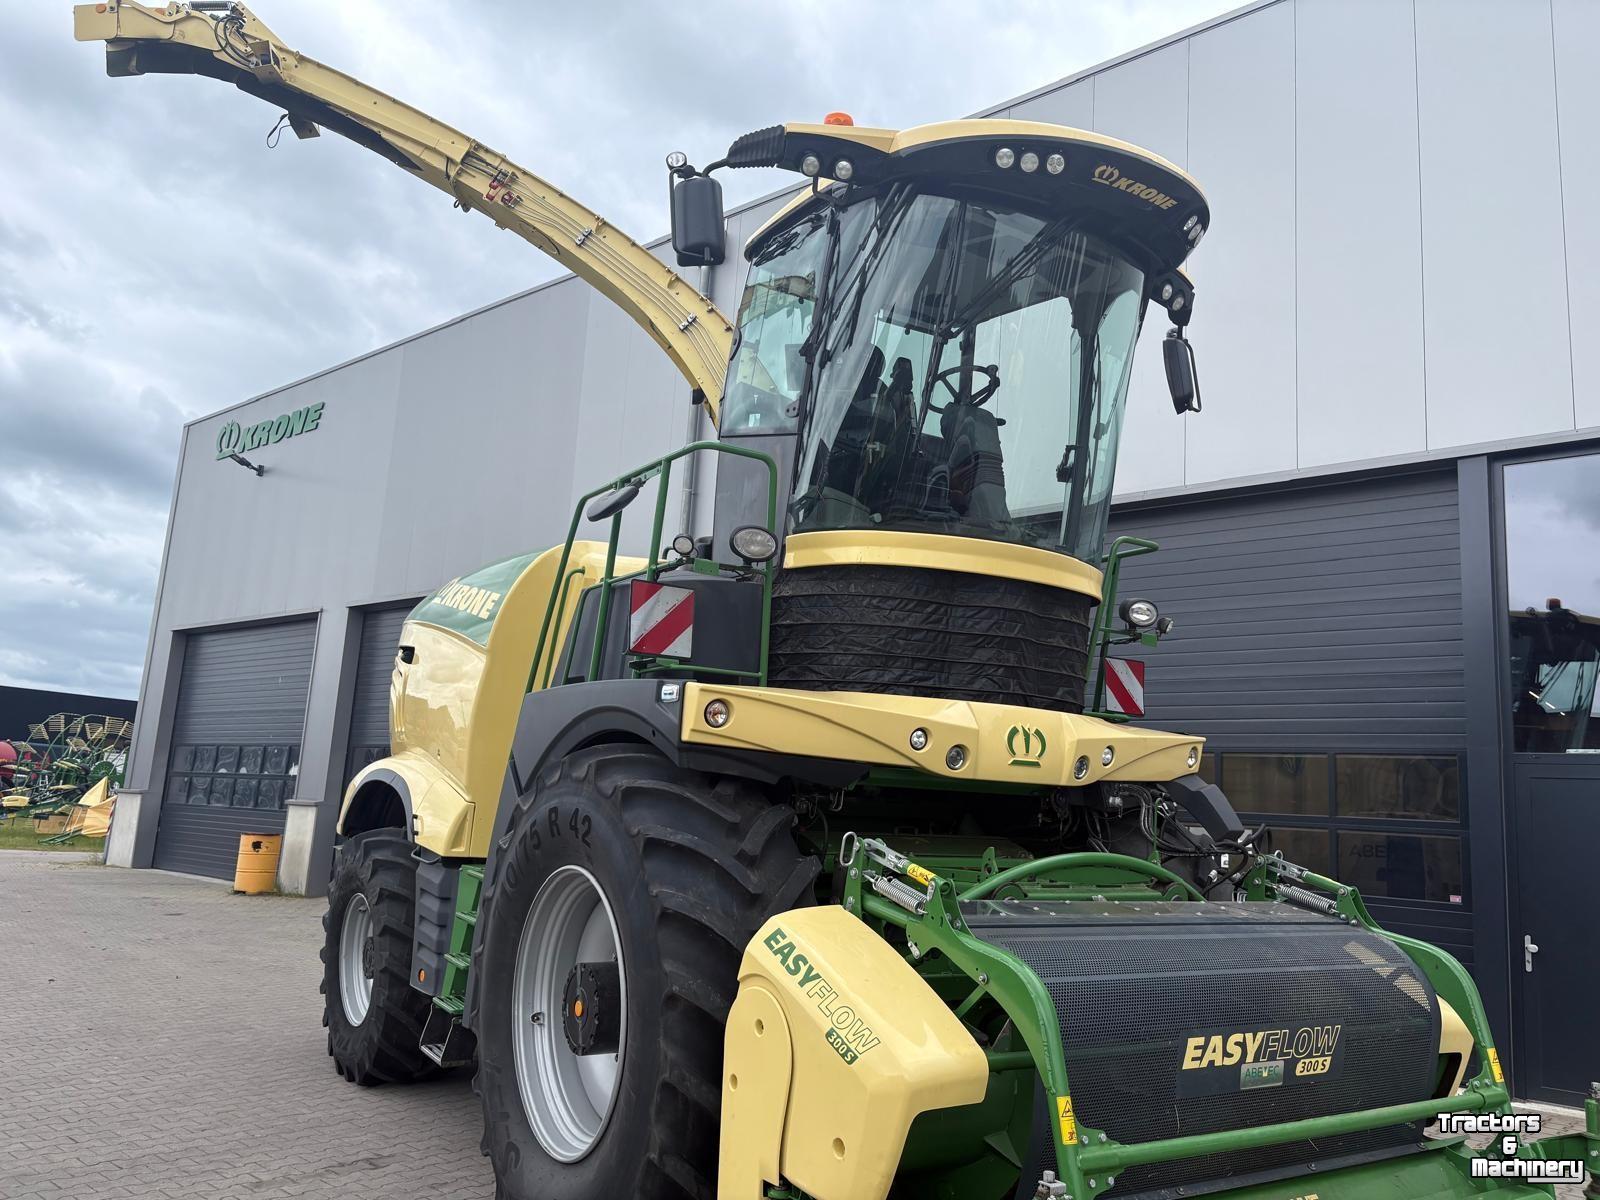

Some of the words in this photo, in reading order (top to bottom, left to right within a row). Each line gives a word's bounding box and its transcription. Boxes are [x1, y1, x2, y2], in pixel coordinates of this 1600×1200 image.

[1112, 178, 1178, 210] KRONE
[239, 401, 325, 454] KRONE
[440, 583, 501, 620] KRONE
[548, 806, 561, 838] R
[569, 807, 592, 848] 42
[763, 927, 881, 1055] EASYFLOW
[1182, 1025, 1341, 1070] EASYFLOW
